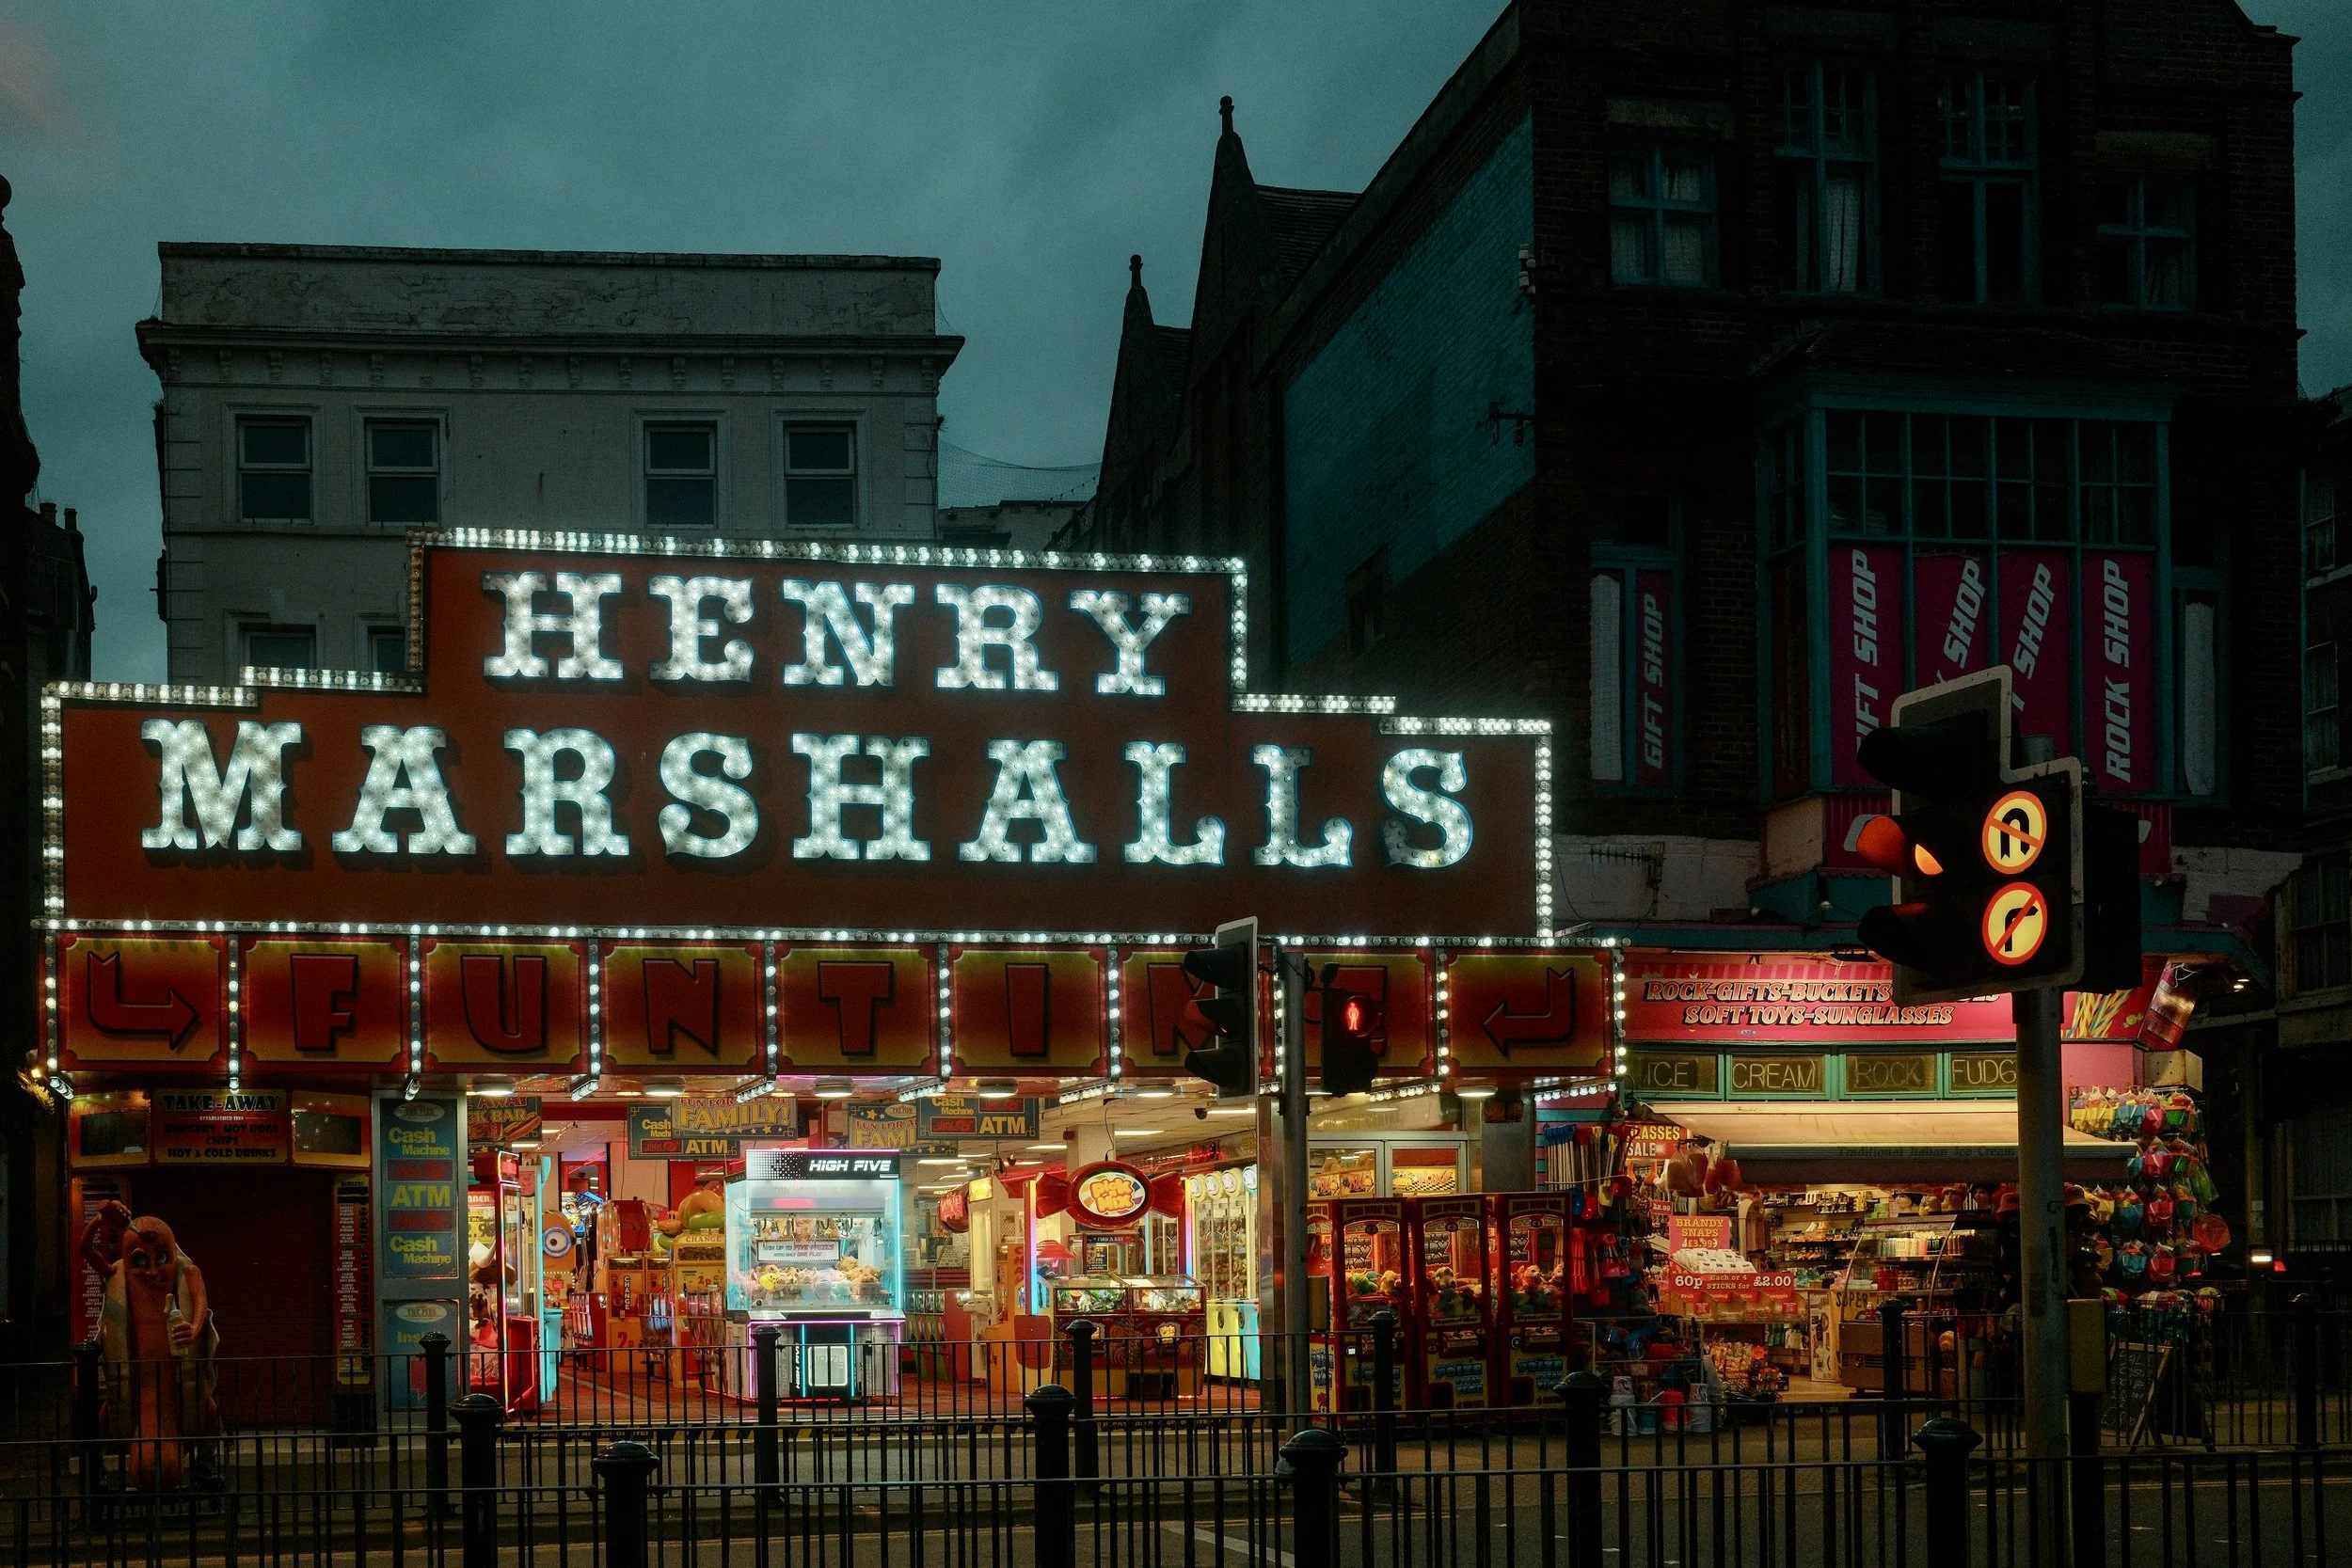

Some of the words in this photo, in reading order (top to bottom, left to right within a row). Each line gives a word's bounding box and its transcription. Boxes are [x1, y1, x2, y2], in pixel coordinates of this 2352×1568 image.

[1851, 549, 1877, 666] SHOP
[1943, 559, 1984, 669] SHOP
[2103, 559, 2129, 667] SHOP
[2011, 562, 2055, 679] SHOP
[482, 570, 1189, 699] HENRY
[1644, 593, 1662, 689] SHOP
[1645, 691, 1663, 769] GIFT
[2105, 673, 2130, 783] ROCK
[141, 719, 1477, 873] MARSHALLS
[1684, 1006, 1747, 1025] SOFT
[1746, 1006, 1954, 1025] TOYS-SUNGLASSES
[1647, 1061, 1689, 1088] ICE
[1732, 1058, 1817, 1089] CREAM
[1855, 1057, 1922, 1087] ROCK
[1952, 1059, 2018, 1085] FUDG
[162, 1095, 279, 1112] TAKE-AWAY
[679, 1098, 704, 1107] FUN
[708, 1098, 733, 1107] FOR
[931, 1096, 964, 1107] Cash
[491, 1109, 526, 1122] BAR
[679, 1102, 791, 1129] FAMILY!
[941, 1107, 974, 1116] Machine
[224, 1124, 246, 1133] HOT
[250, 1124, 278, 1133] DOGS
[641, 1119, 671, 1131] Cash
[855, 1120, 875, 1130] FUN
[880, 1121, 902, 1130] FOR
[978, 1117, 1025, 1134] ATM
[205, 1136, 238, 1145] CHIPS
[388, 1127, 436, 1145] Cash
[167, 1148, 191, 1158] HOT
[204, 1148, 232, 1158] COLD
[235, 1148, 277, 1158] DRINKS
[402, 1145, 450, 1156] Machine
[684, 1139, 728, 1154] ATM
[1627, 1142, 1656, 1157] SALE
[1838, 1147, 1902, 1157] Traditional
[1910, 1147, 1947, 1157] Italian
[1954, 1147, 1972, 1156] Ice
[1978, 1147, 2014, 1156] Cream
[809, 1160, 849, 1171] HIGH
[853, 1160, 891, 1171] FIVE
[391, 1185, 451, 1208] ATM
[1090, 1179, 1134, 1198] Pick
[1097, 1194, 1134, 1212] Mix
[1676, 1218, 1724, 1227] BRANDY
[390, 1236, 437, 1253] Cash
[403, 1253, 452, 1266] Machine
[697, 1275, 711, 1288] 2p
[1675, 1275, 1703, 1290] 60p
[1753, 1275, 1791, 1288] £2.00
[1836, 1291, 1867, 1308] SUPER
